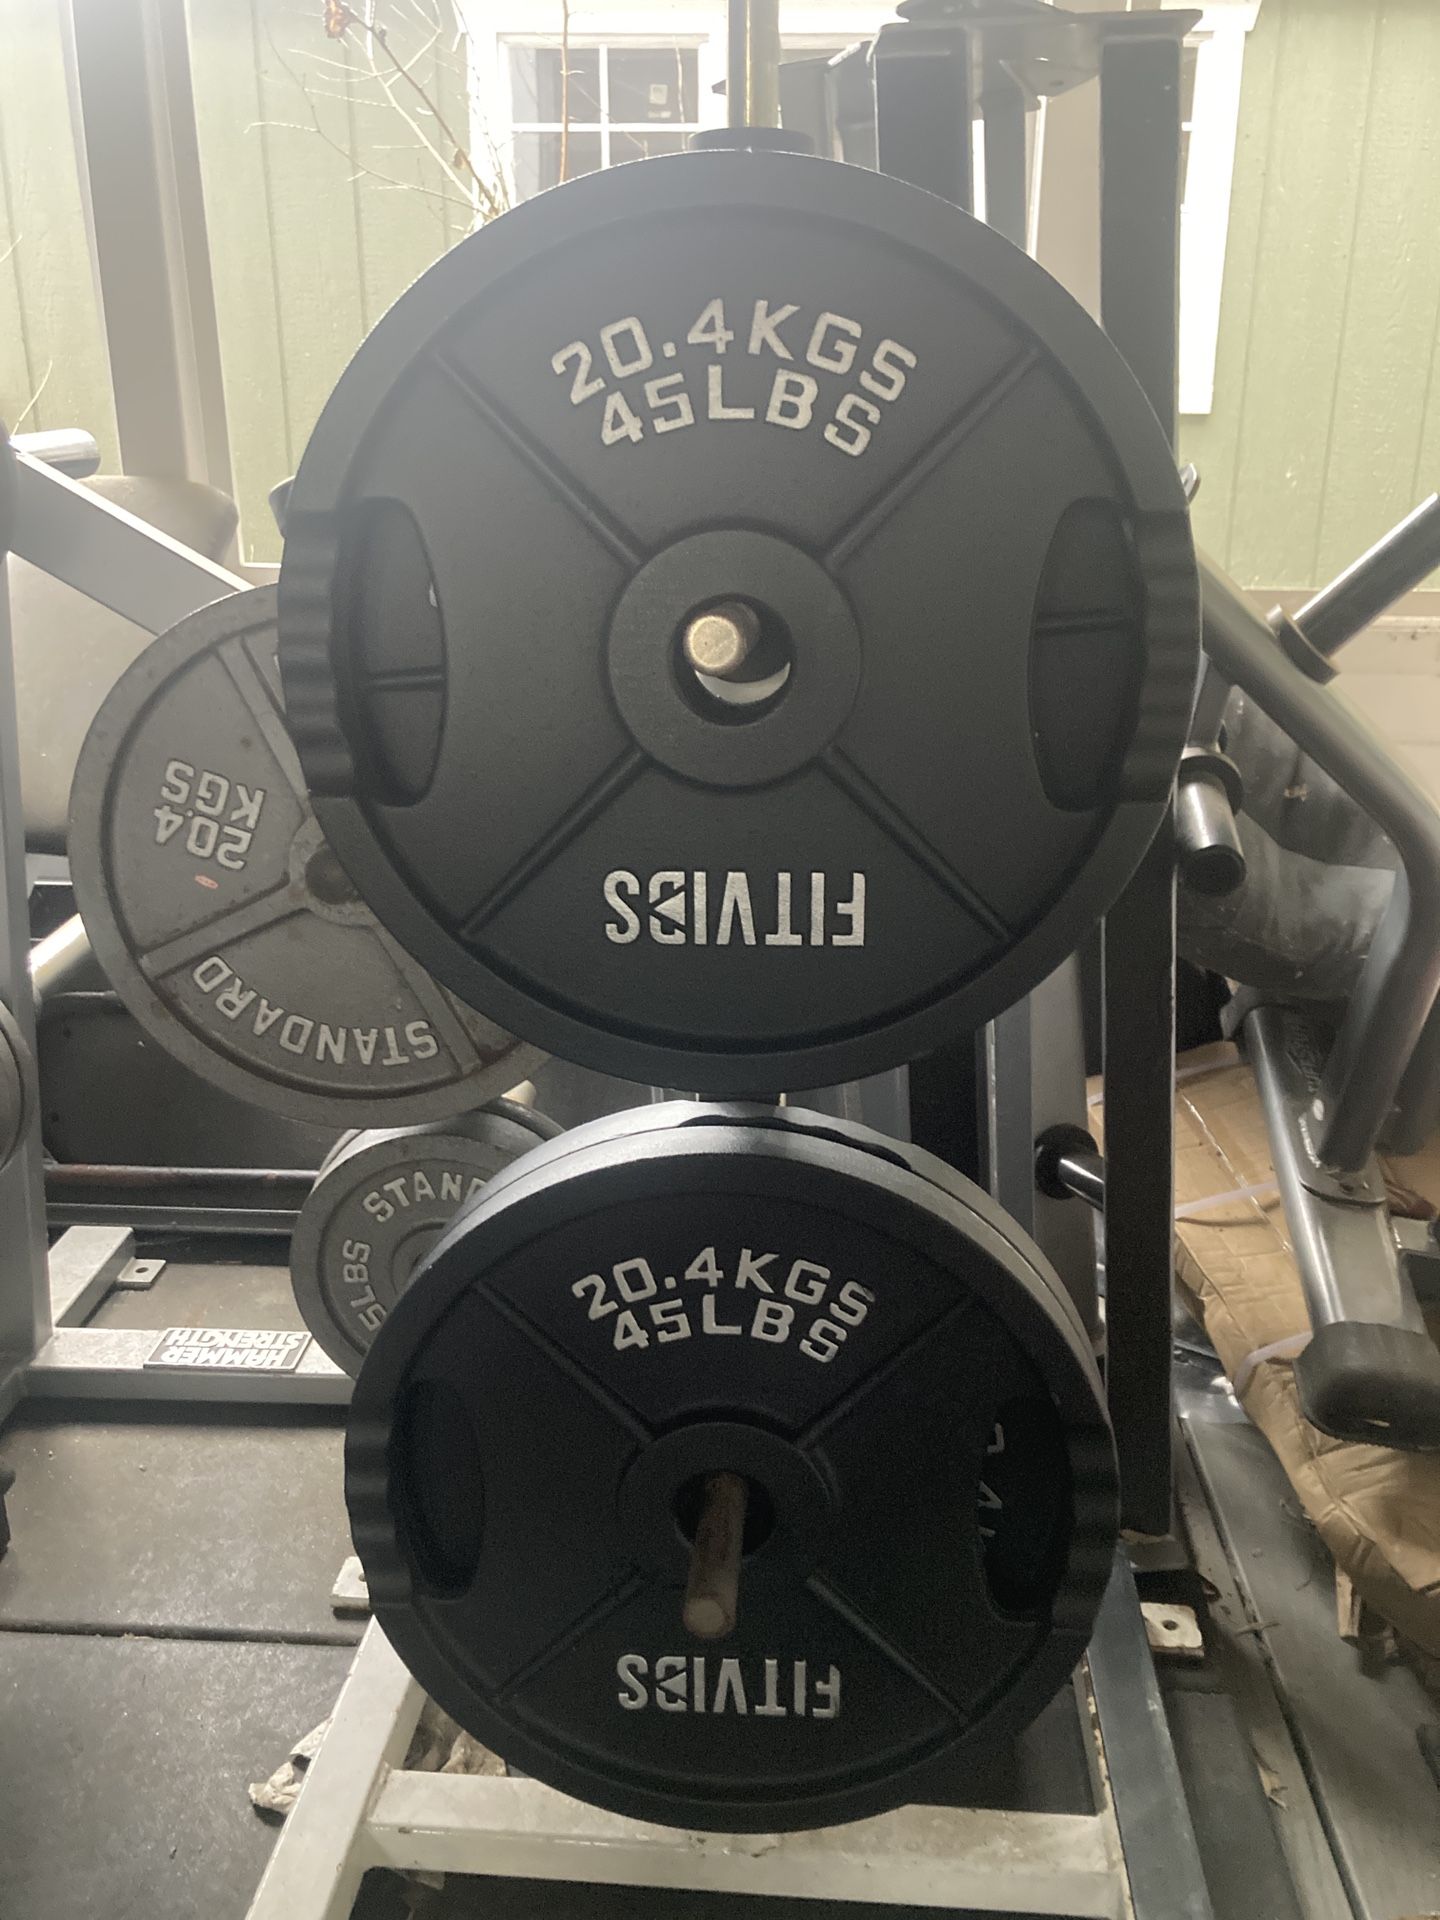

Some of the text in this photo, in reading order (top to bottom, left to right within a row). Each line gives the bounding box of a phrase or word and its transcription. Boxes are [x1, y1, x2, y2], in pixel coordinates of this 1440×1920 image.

[551, 298, 917, 402] 20.4KGS
[601, 364, 881, 457] 45LBS
[160, 758, 266, 830] KGS
[603, 870, 866, 946] FITVIDS
[192, 955, 438, 1065] STANDARD
[572, 1247, 876, 1327] 20.4KGS
[161, 1346, 288, 1367] HAMMER
[165, 1329, 302, 1350] STRENGTH
[612, 1294, 848, 1363] 45LBS
[616, 1653, 841, 1718] FITVIDS
